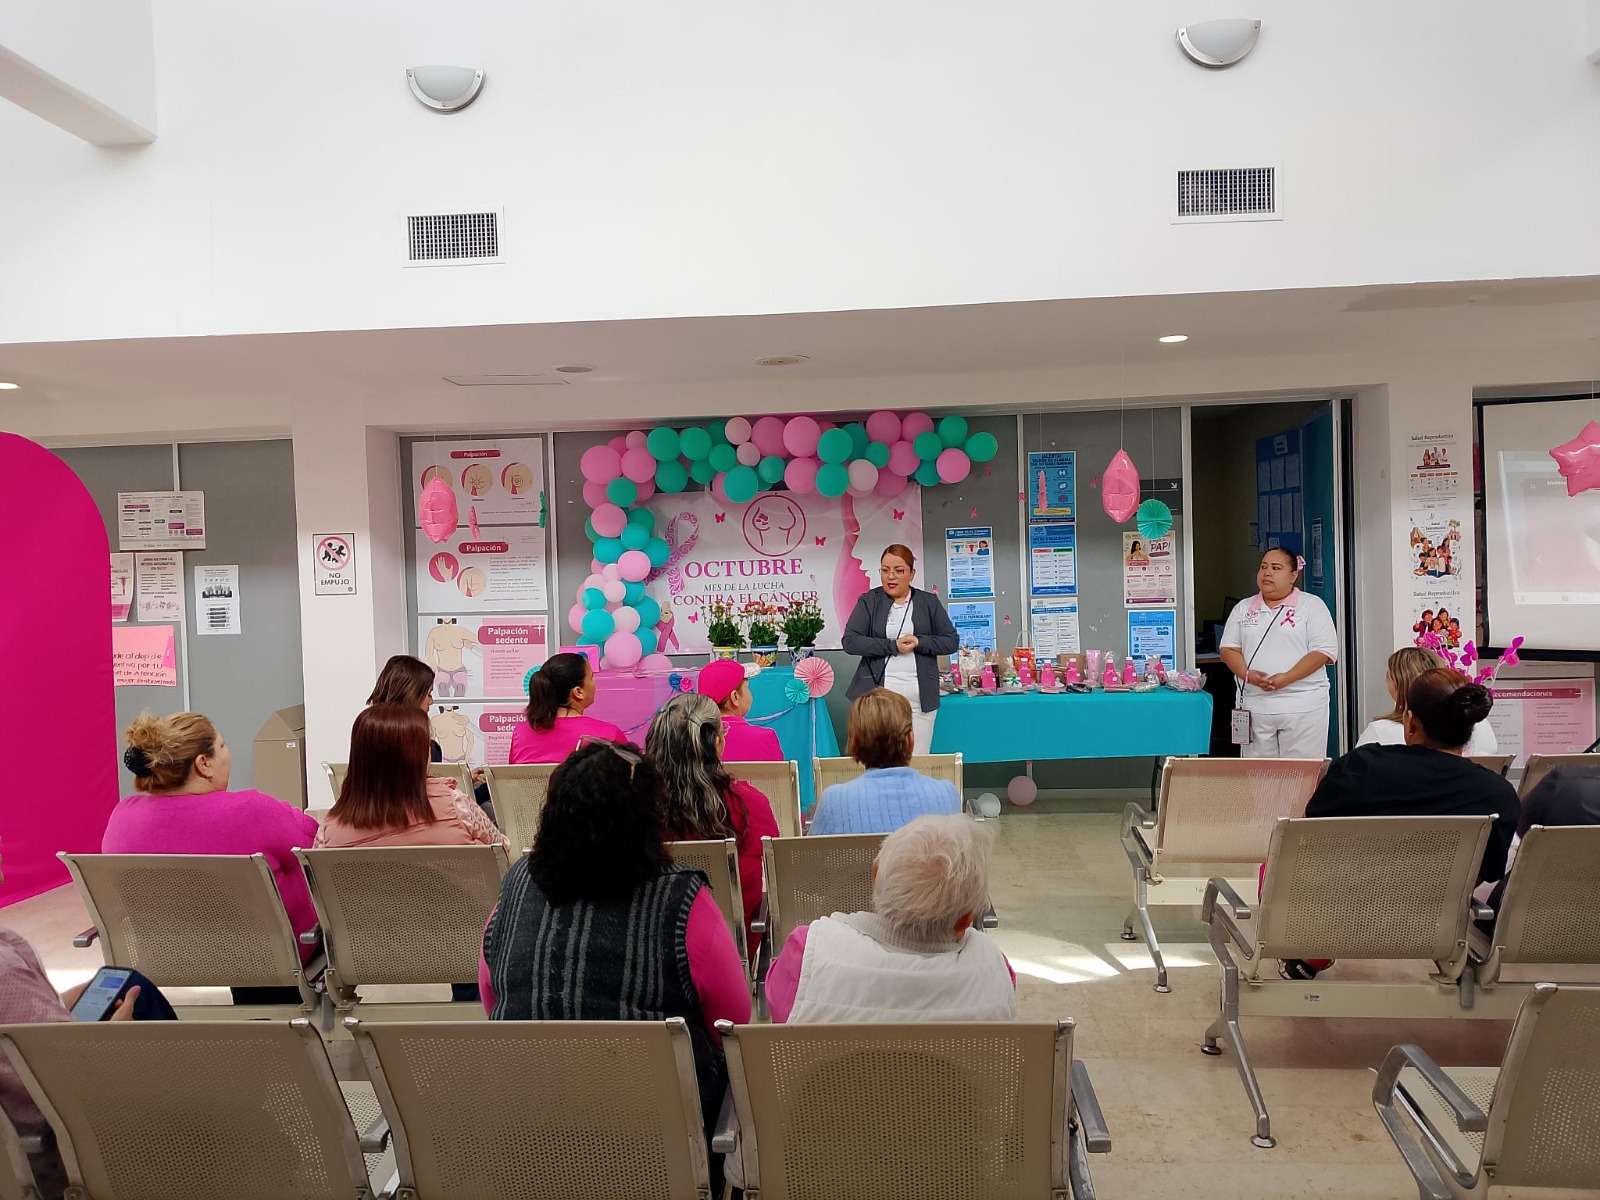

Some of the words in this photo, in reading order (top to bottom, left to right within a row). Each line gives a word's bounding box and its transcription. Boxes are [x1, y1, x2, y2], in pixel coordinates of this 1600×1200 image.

[1150, 542, 1171, 552] PAP!
[684, 558, 803, 578] OCTUBRE
[703, 583, 722, 592] MES
[724, 583, 736, 591] DE
[738, 582, 750, 591] LA
[752, 581, 785, 591] LUCHA
[673, 593, 735, 606] CONTRA
[740, 593, 753, 604] EL
[759, 590, 820, 604] CÁNCER
[488, 627, 529, 637] Palpación
[495, 636, 529, 644] sedente
[137, 662, 150, 670] por
[1494, 690, 1553, 698] ecomendaciones
[496, 723, 516, 731] sede
